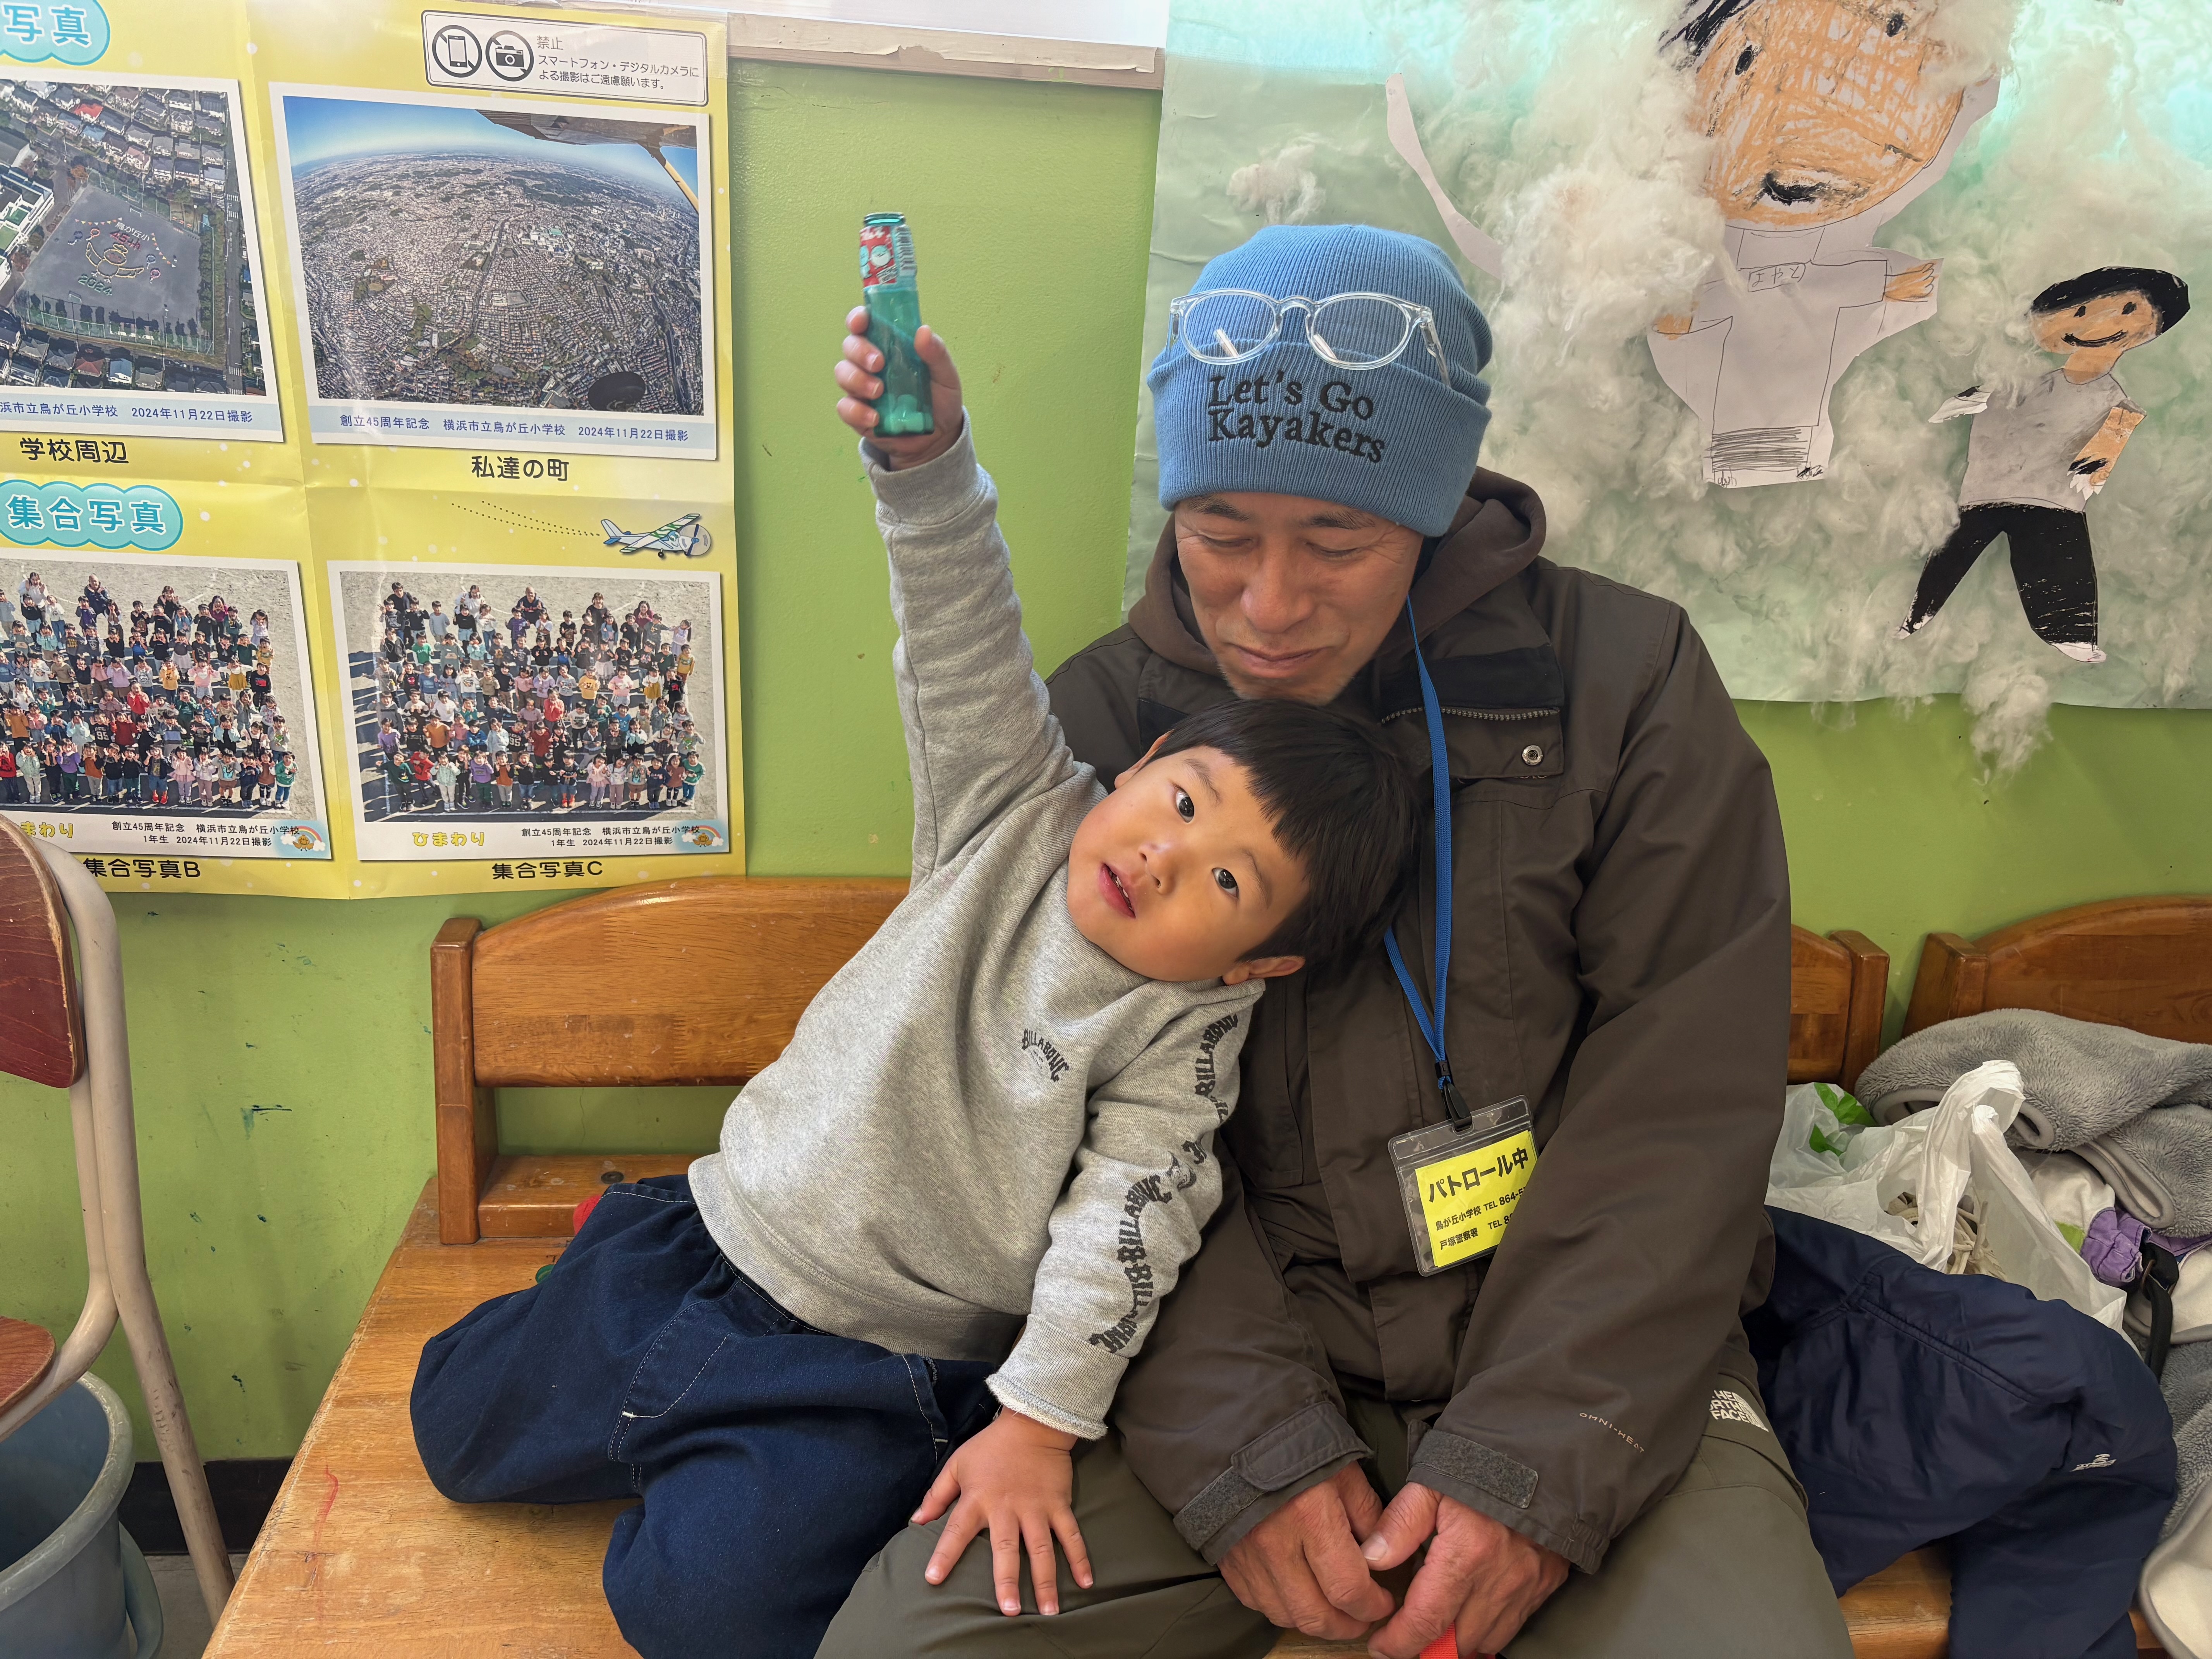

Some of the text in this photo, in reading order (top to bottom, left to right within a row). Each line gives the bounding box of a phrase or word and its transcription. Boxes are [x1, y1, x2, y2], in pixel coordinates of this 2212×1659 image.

[2, 3, 91, 47] 写真
[537, 36, 563, 50] 禁止
[538, 55, 699, 77] スマートフォン・デジタルカメラに
[539, 70, 664, 89] よる撮影はご遠慮願います。
[1208, 370, 1374, 420] Let's Go
[0, 402, 253, 423] 浜市立鳥が丘小学校 2024年11月22日撮影
[340, 414, 689, 441] 創立45周年記念 横浜市立鳥が丘小学校 2024年11月22日撮影
[1208, 408, 1385, 463] Kayakers
[19, 437, 129, 464] 学校周辺
[471, 455, 570, 481] 私達の町
[7, 494, 167, 535] 集合写真
[112, 821, 300, 835] 創立45周年記念 横浜市立鳥が丘小学校
[412, 832, 484, 847] ひまわり
[521, 825, 700, 837] 創立45周年記念 横浜市立鳥が丘小学校
[143, 835, 272, 847] 1年生 2024年11月22日撮影
[583, 837, 673, 846] 2024年11月22日撮影
[83, 858, 201, 878] 集合写真B
[491, 860, 603, 879] 集合写真C
[1022, 1028, 1069, 1082] BILLABONG
[1429, 1147, 1528, 1202] パトロール中
[1117, 1175, 1173, 1264] BILLABONG
[1436, 1186, 1526, 1231] 鳥が丘小学校 TEL 864-5
[1439, 1228, 1478, 1250] 戸塚警察署
[1487, 1219, 1503, 1230] TEL
[1712, 1390, 1736, 1401] HE
[1710, 1409, 1750, 1423] FACE
[1579, 1413, 1644, 1453] OMNI-HEAT
